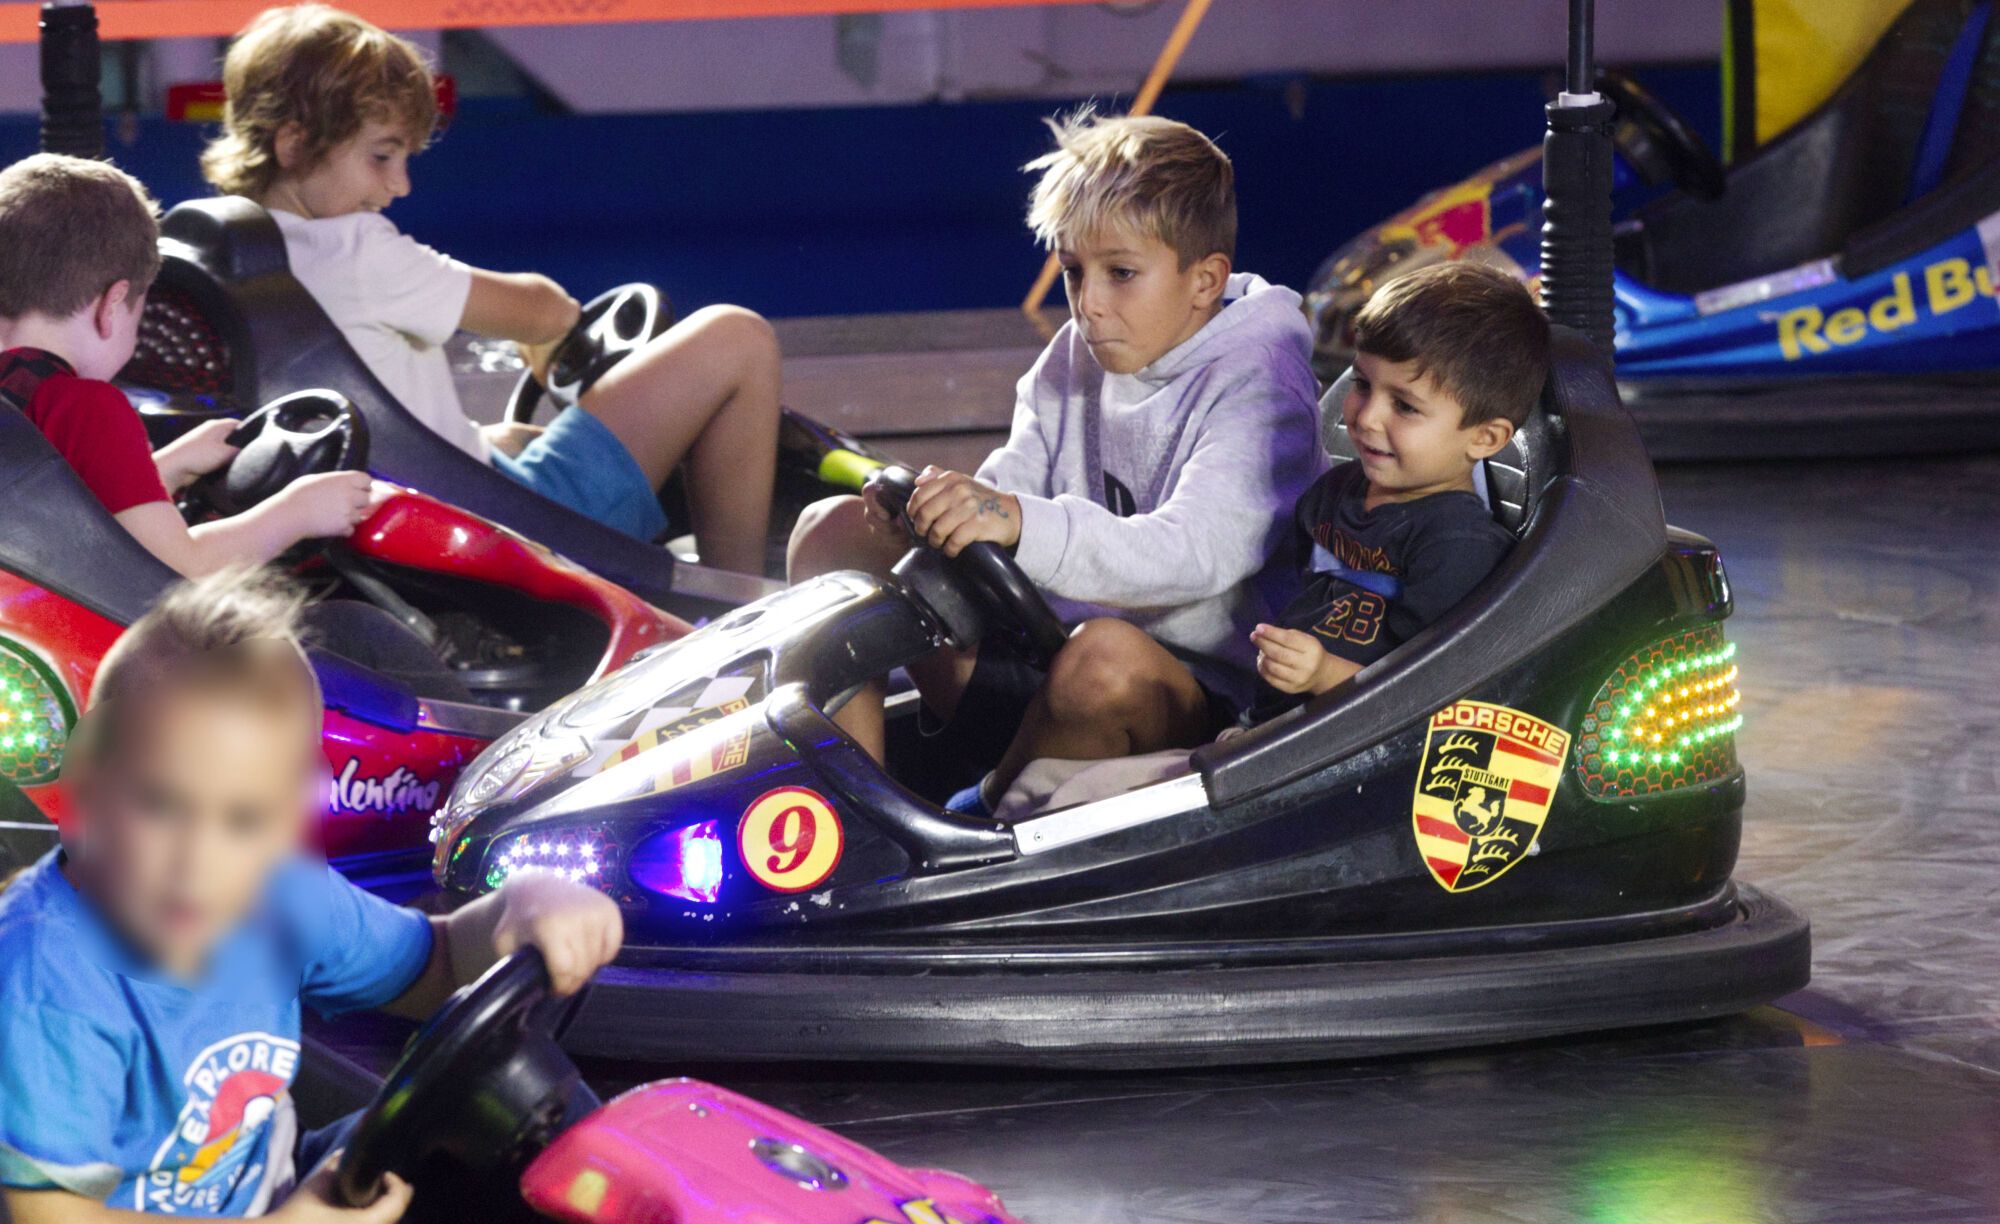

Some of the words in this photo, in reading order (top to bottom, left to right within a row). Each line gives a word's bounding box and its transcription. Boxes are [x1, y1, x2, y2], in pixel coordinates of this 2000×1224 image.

[1778, 271, 1917, 360] Red
[1924, 257, 2000, 316] Bu
[1312, 591, 1386, 646] 28
[1437, 705, 1566, 754] PORSCHE
[1463, 767, 1511, 789] STUTTGART
[766, 805, 817, 875] 9
[181, 1041, 298, 1146] EXPLORE
